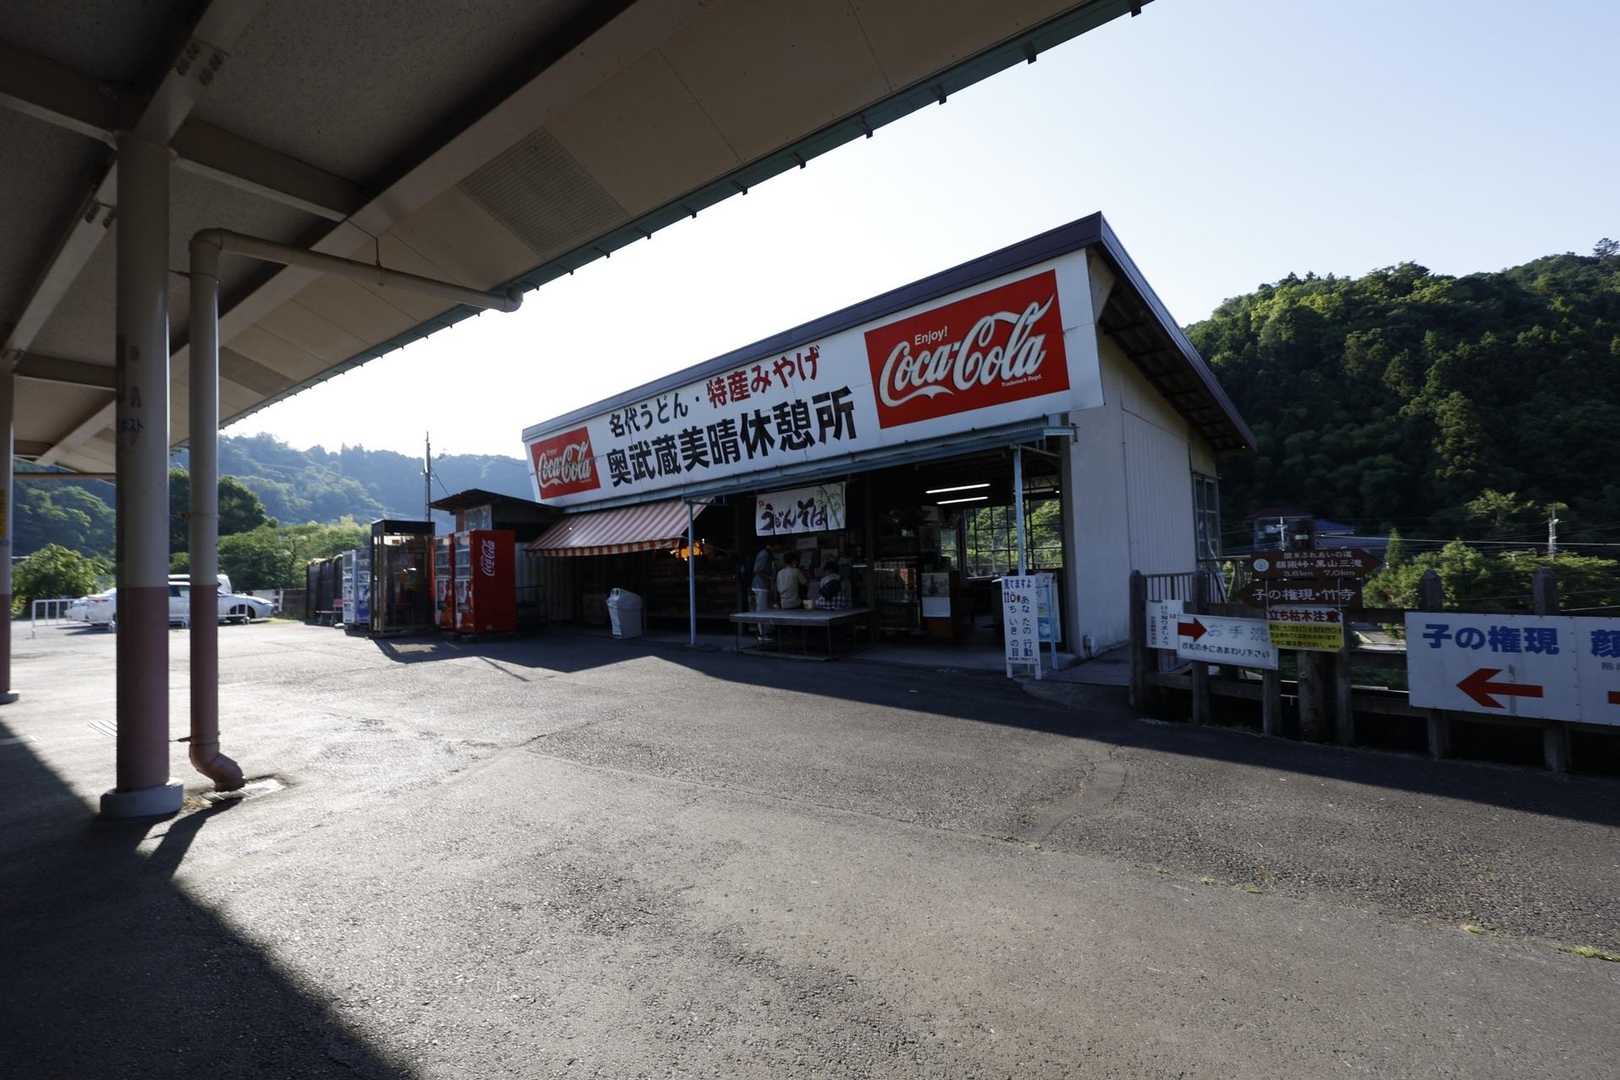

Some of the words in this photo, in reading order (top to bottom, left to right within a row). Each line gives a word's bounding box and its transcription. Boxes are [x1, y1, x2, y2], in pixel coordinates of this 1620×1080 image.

[880, 293, 1055, 408] Coca-Cola
[914, 326, 948, 346] Enjoy!
[606, 385, 857, 487] 奥武蔵美晴休憩所
[538, 439, 592, 489] Coca-Cola
[1423, 623, 1560, 655] 子の権現
